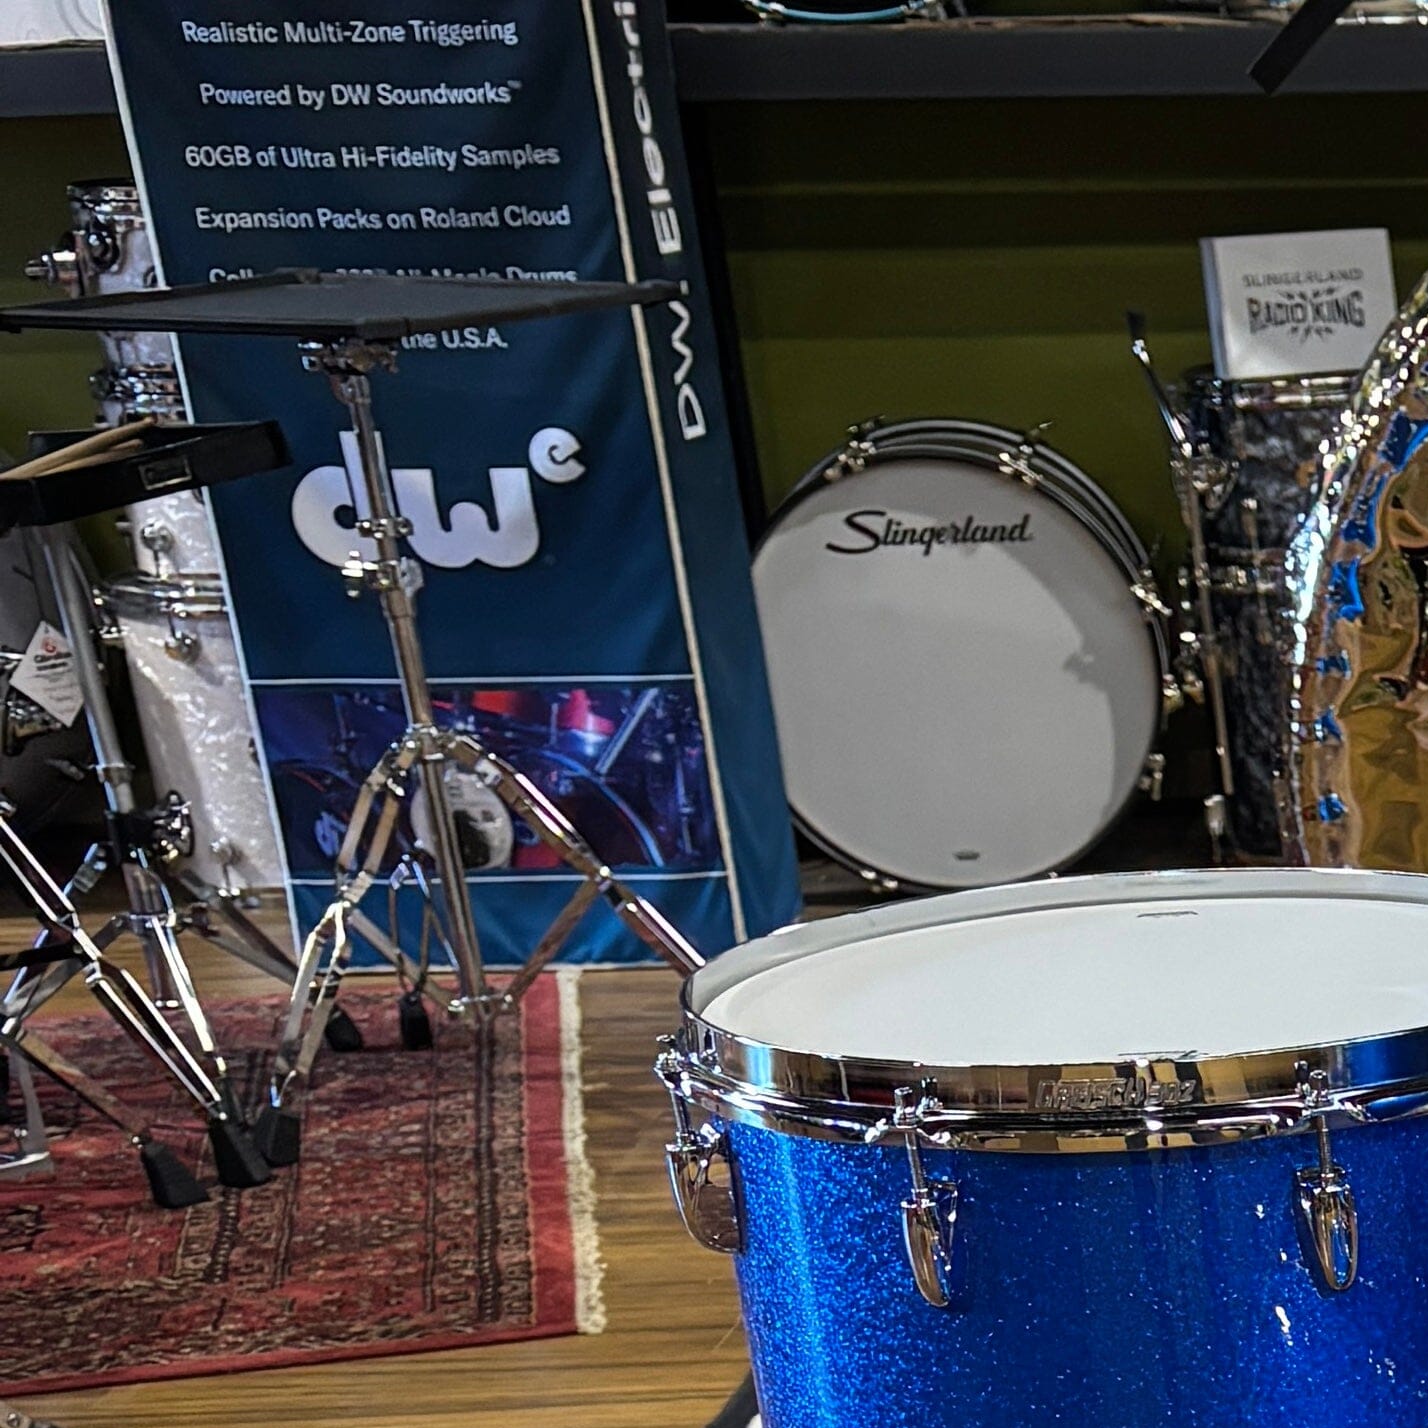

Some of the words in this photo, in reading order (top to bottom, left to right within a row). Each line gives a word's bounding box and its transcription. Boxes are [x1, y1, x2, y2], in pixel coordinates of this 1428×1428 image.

[181, 21, 278, 43] Realistic
[283, 21, 406, 43] Multi-Zone
[408, 20, 519, 46] Triggering
[199, 83, 291, 105] Powered
[296, 84, 325, 110] by
[331, 84, 371, 105] DW
[185, 145, 250, 167] 60GB
[255, 146, 277, 167] of
[280, 147, 336, 168] Ultra
[341, 146, 457, 172] Hi-Fidelity
[461, 144, 560, 169] Samples
[195, 207, 314, 233] Expansion
[316, 208, 382, 230] Packs
[386, 212, 416, 230] on
[420, 206, 499, 229] Roland
[503, 205, 571, 227] Cloud
[1310, 290, 1365, 328] KING
[441, 326, 508, 349] U.S.A.
[825, 509, 1034, 557] Slingerland
